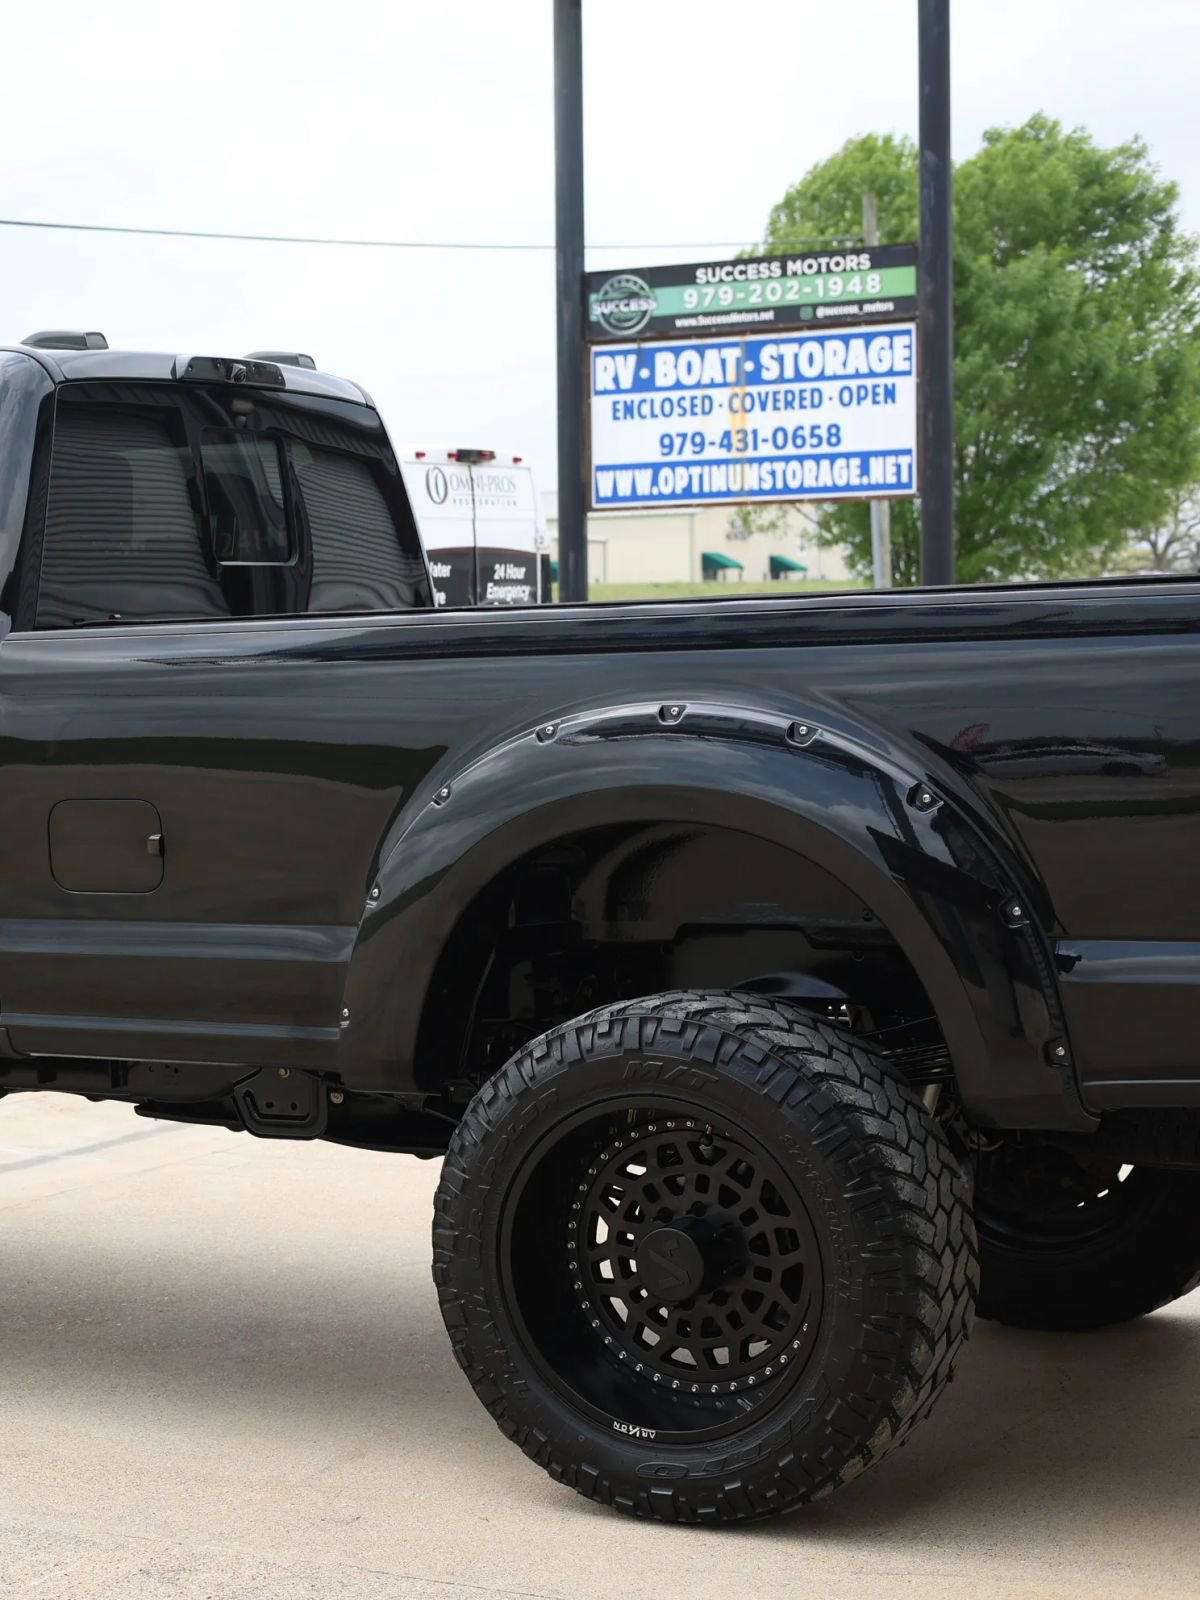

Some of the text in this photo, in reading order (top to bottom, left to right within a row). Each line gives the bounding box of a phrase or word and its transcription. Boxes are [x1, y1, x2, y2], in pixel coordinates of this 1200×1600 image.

[695, 254, 871, 285] SUCCESS MOTORS
[592, 297, 657, 315] SUCCESS
[683, 274, 882, 309] 979-202-1948
[594, 334, 912, 391] RV BOAT STORAGE
[612, 382, 897, 421] ENCLOSED COVERED OPEN
[659, 423, 842, 457] 979-431-0658
[494, 563, 526, 580] 24 Hour
[486, 582, 531, 602] Emergency
